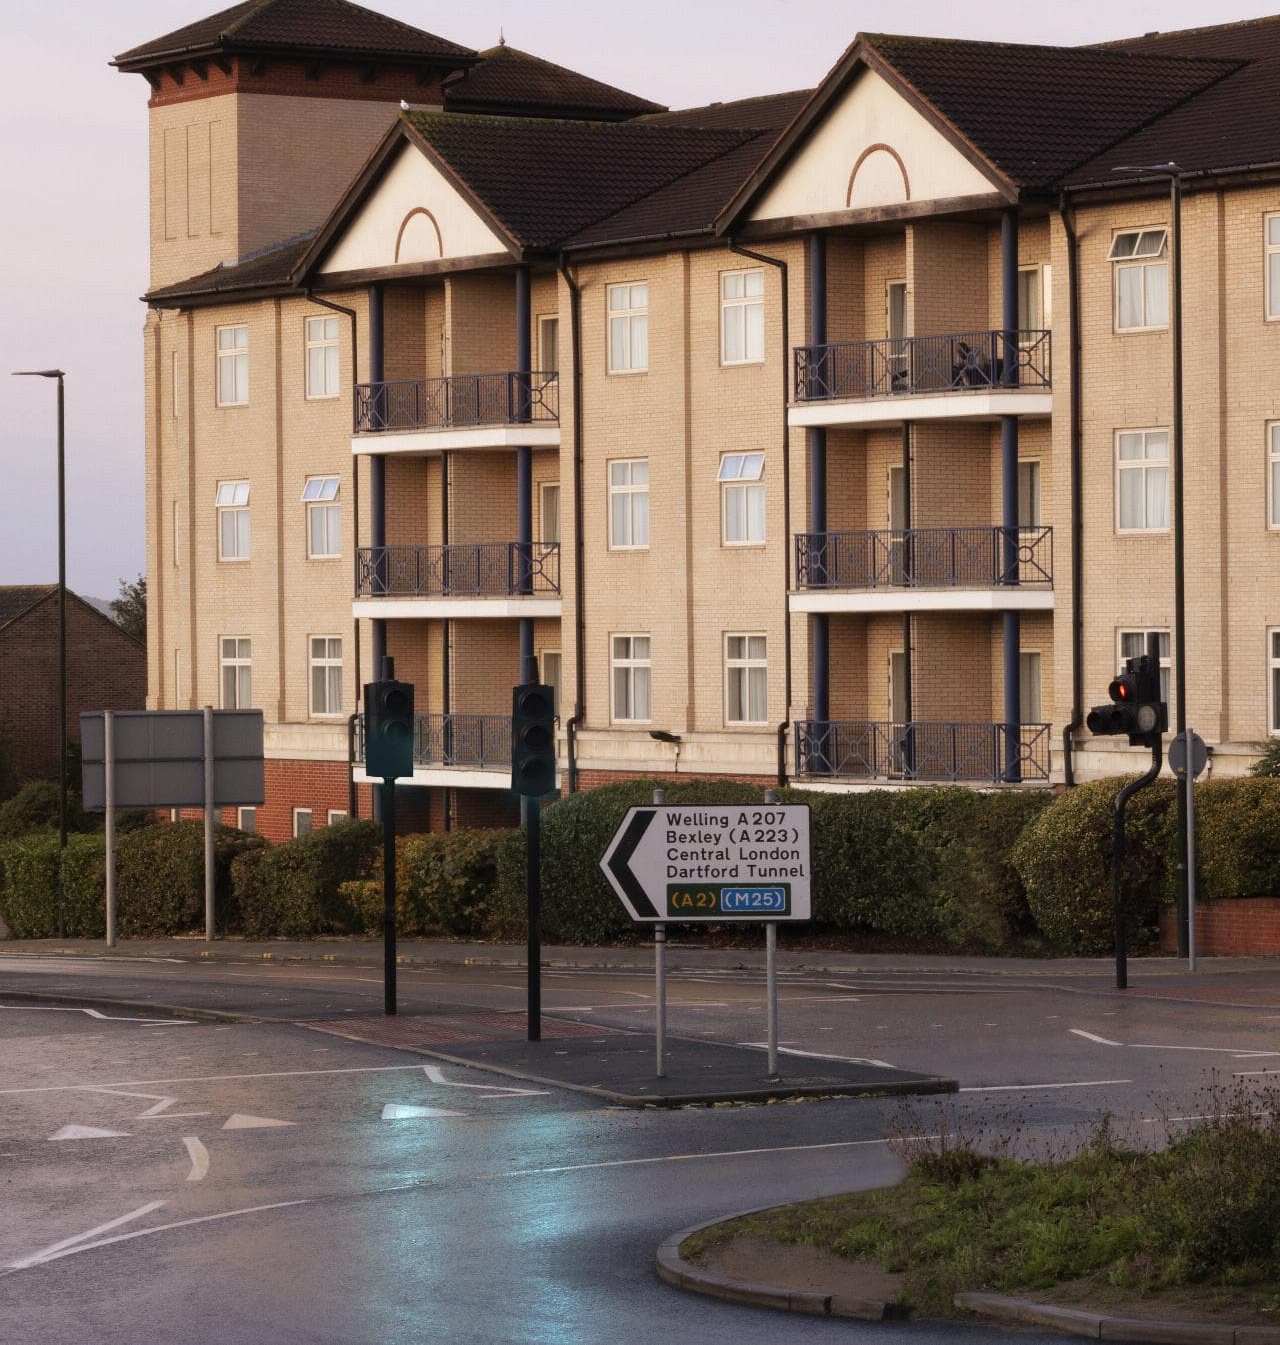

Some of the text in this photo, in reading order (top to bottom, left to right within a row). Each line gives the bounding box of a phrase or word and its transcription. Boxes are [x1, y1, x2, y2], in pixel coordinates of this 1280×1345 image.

[666, 812, 729, 828] Welling
[666, 830, 722, 845] Bexley
[666, 847, 800, 861] Central London
[666, 864, 805, 878] Dartford Tunnel
[671, 891, 782, 908] (A2) (M25)
